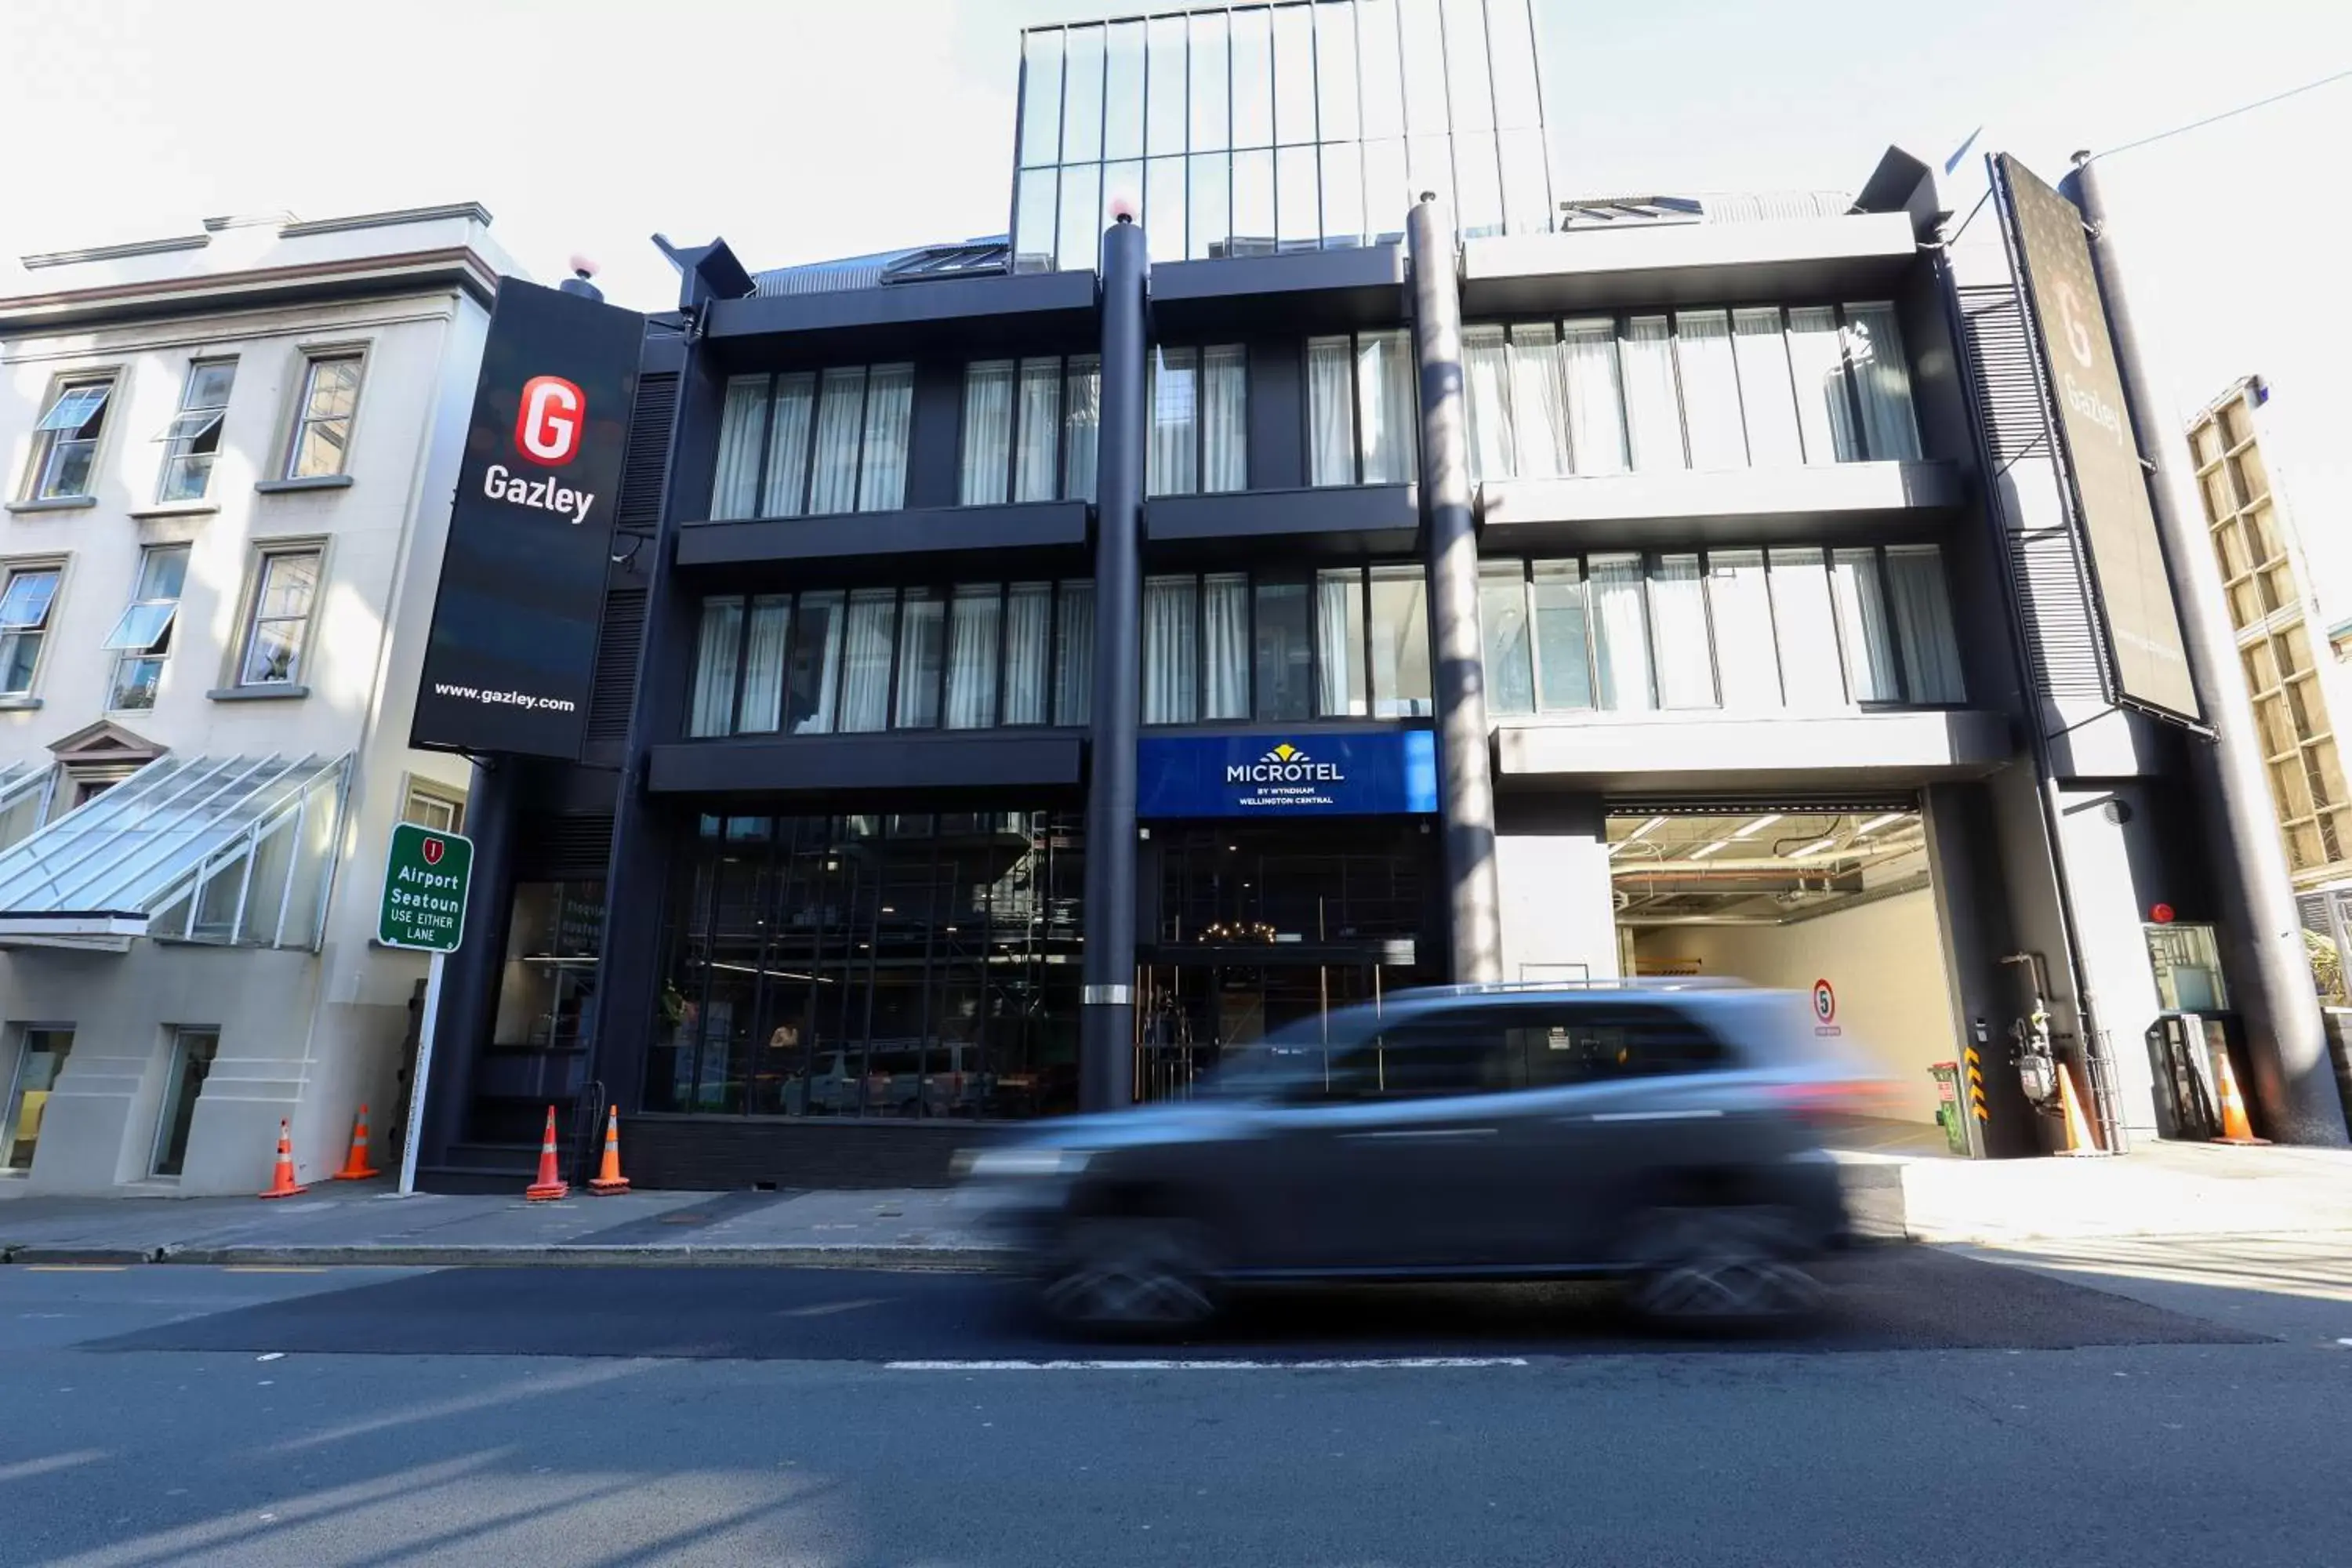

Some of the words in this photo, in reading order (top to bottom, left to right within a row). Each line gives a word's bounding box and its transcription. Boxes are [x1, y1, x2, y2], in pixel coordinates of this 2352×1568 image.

[524, 382, 577, 459] G
[484, 464, 594, 524] Gazley
[435, 683, 575, 712] www.gazley.com
[1227, 764, 1345, 782] MICROTEL
[430, 842, 437, 858] 1
[398, 865, 459, 890] Airport
[391, 887, 459, 913] Seatoun
[391, 909, 412, 924] USE
[417, 913, 453, 929] EITHER
[407, 926, 435, 942] LANE
[1820, 990, 1829, 1014] 5
